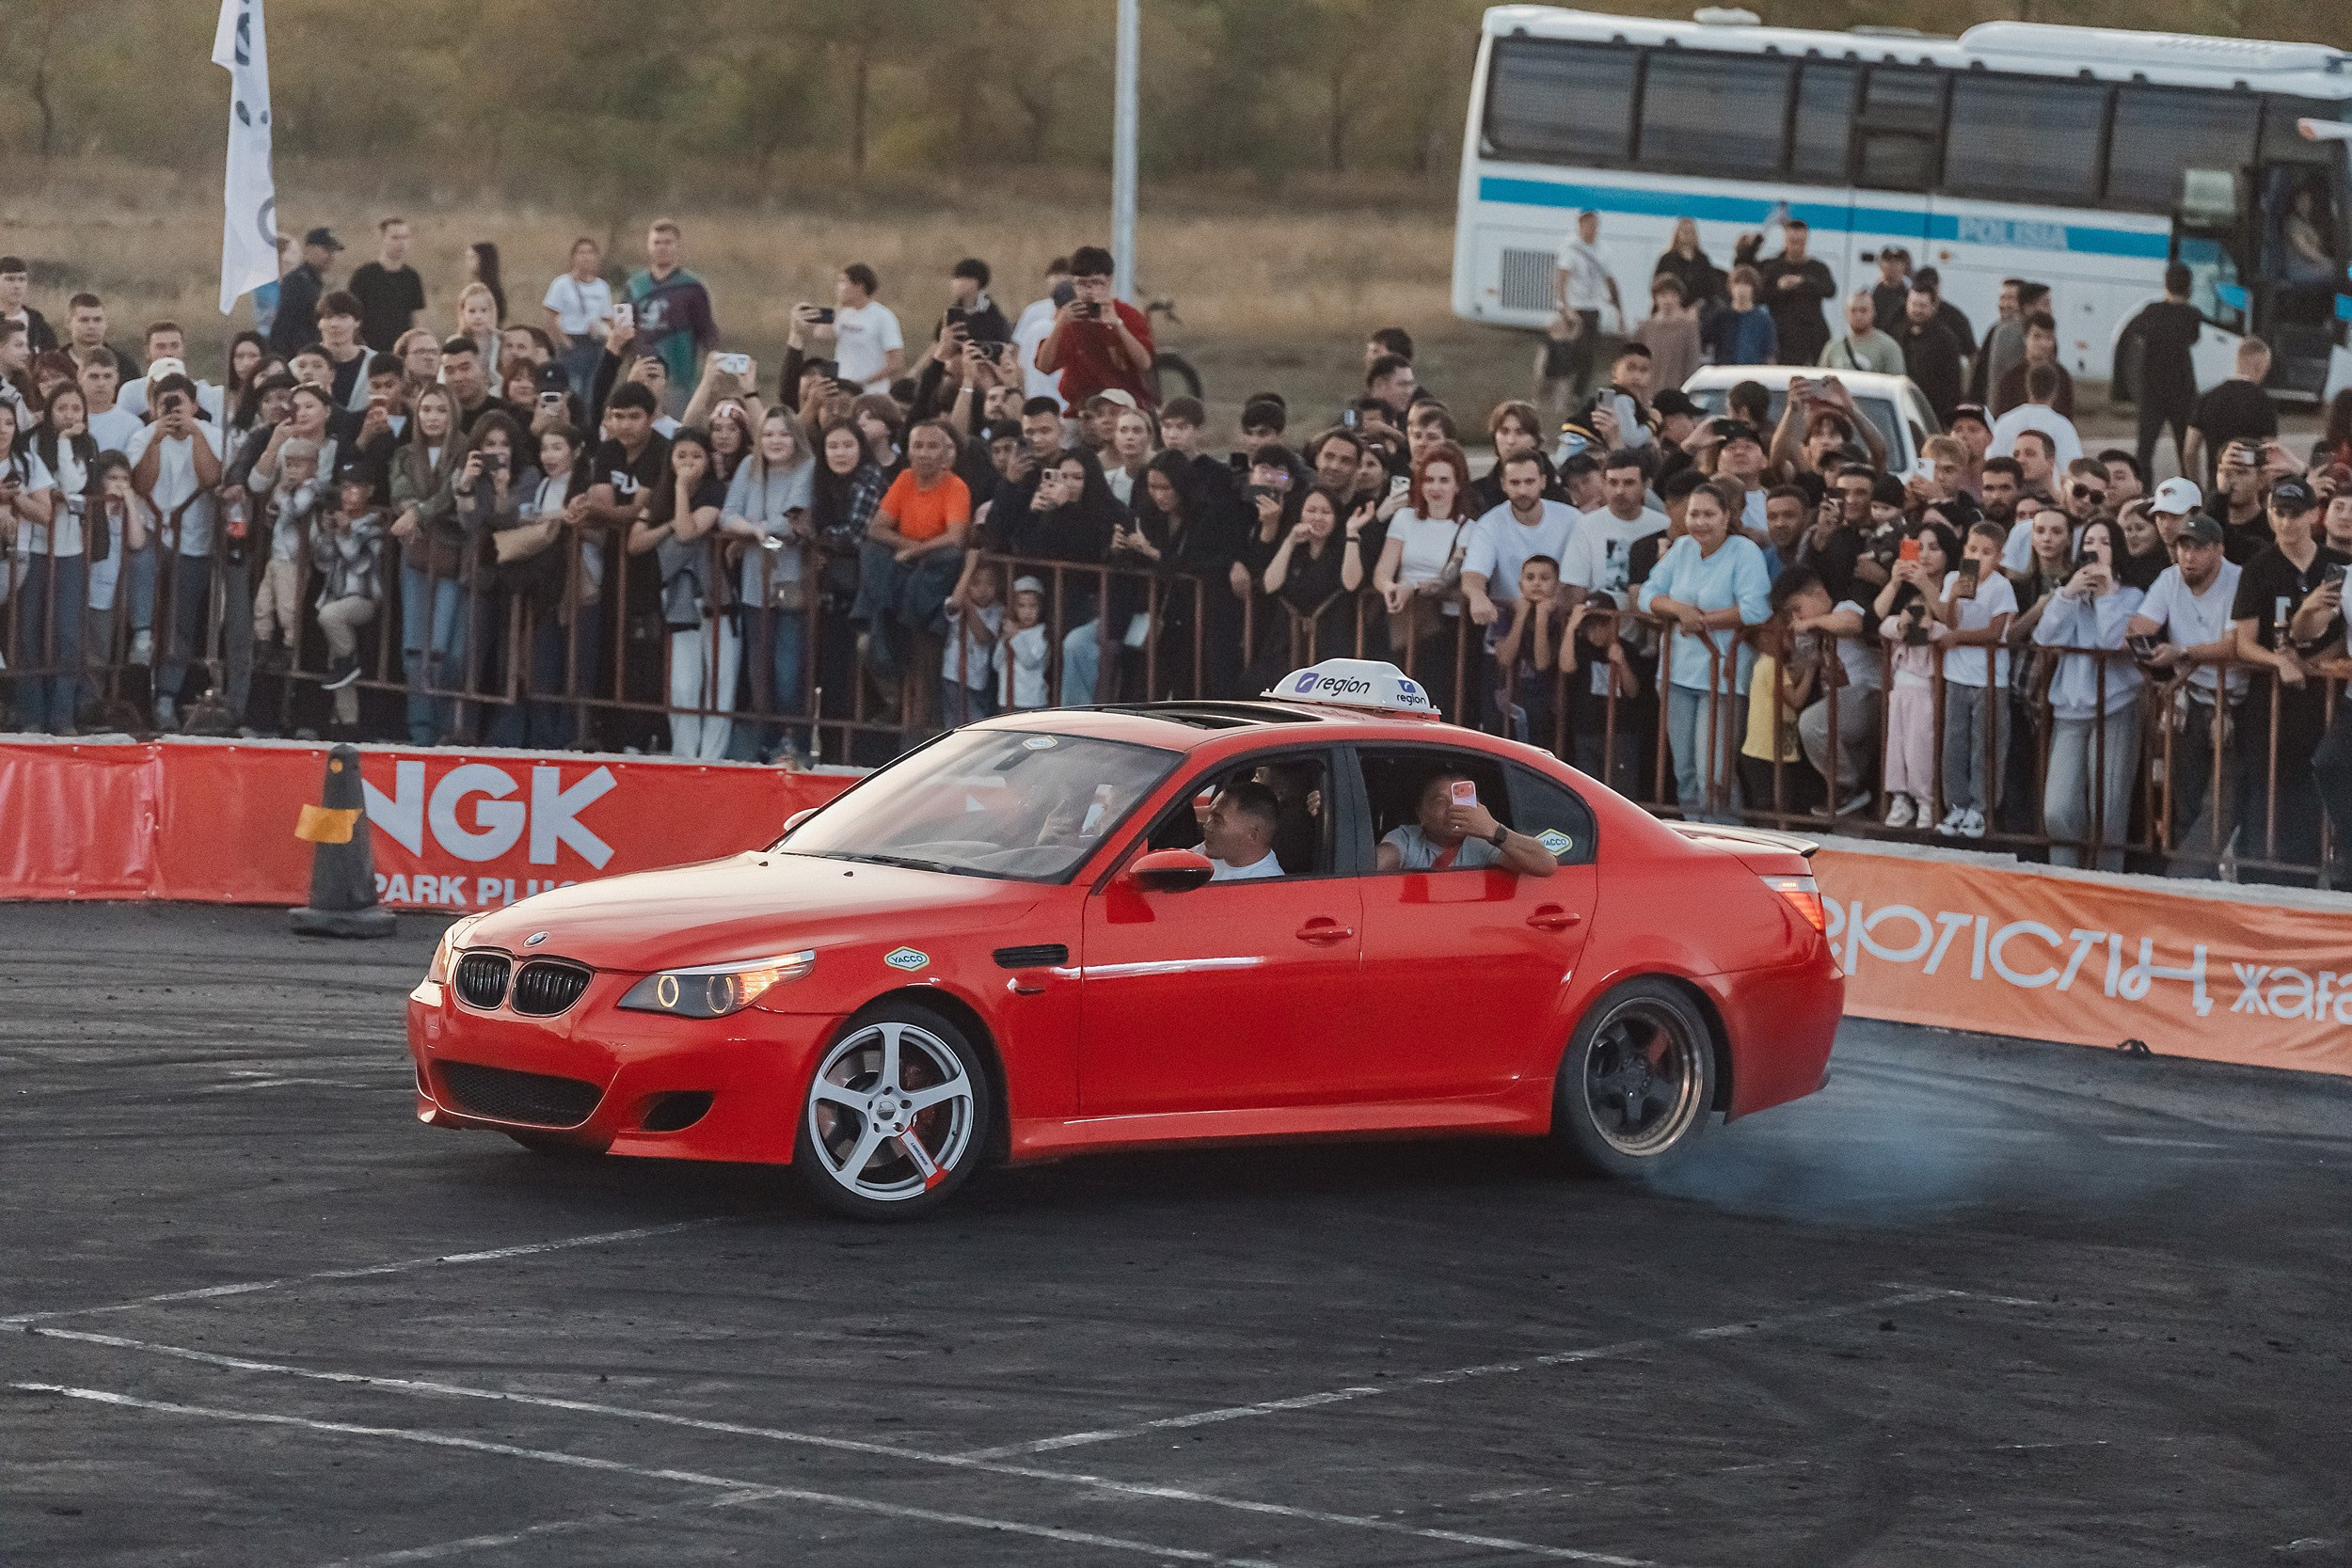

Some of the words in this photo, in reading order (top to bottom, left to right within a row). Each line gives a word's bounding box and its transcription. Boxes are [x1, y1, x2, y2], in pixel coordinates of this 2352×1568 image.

[1315, 676, 1371, 696] region
[1396, 693, 1426, 705] region
[361, 760, 618, 871] NGK
